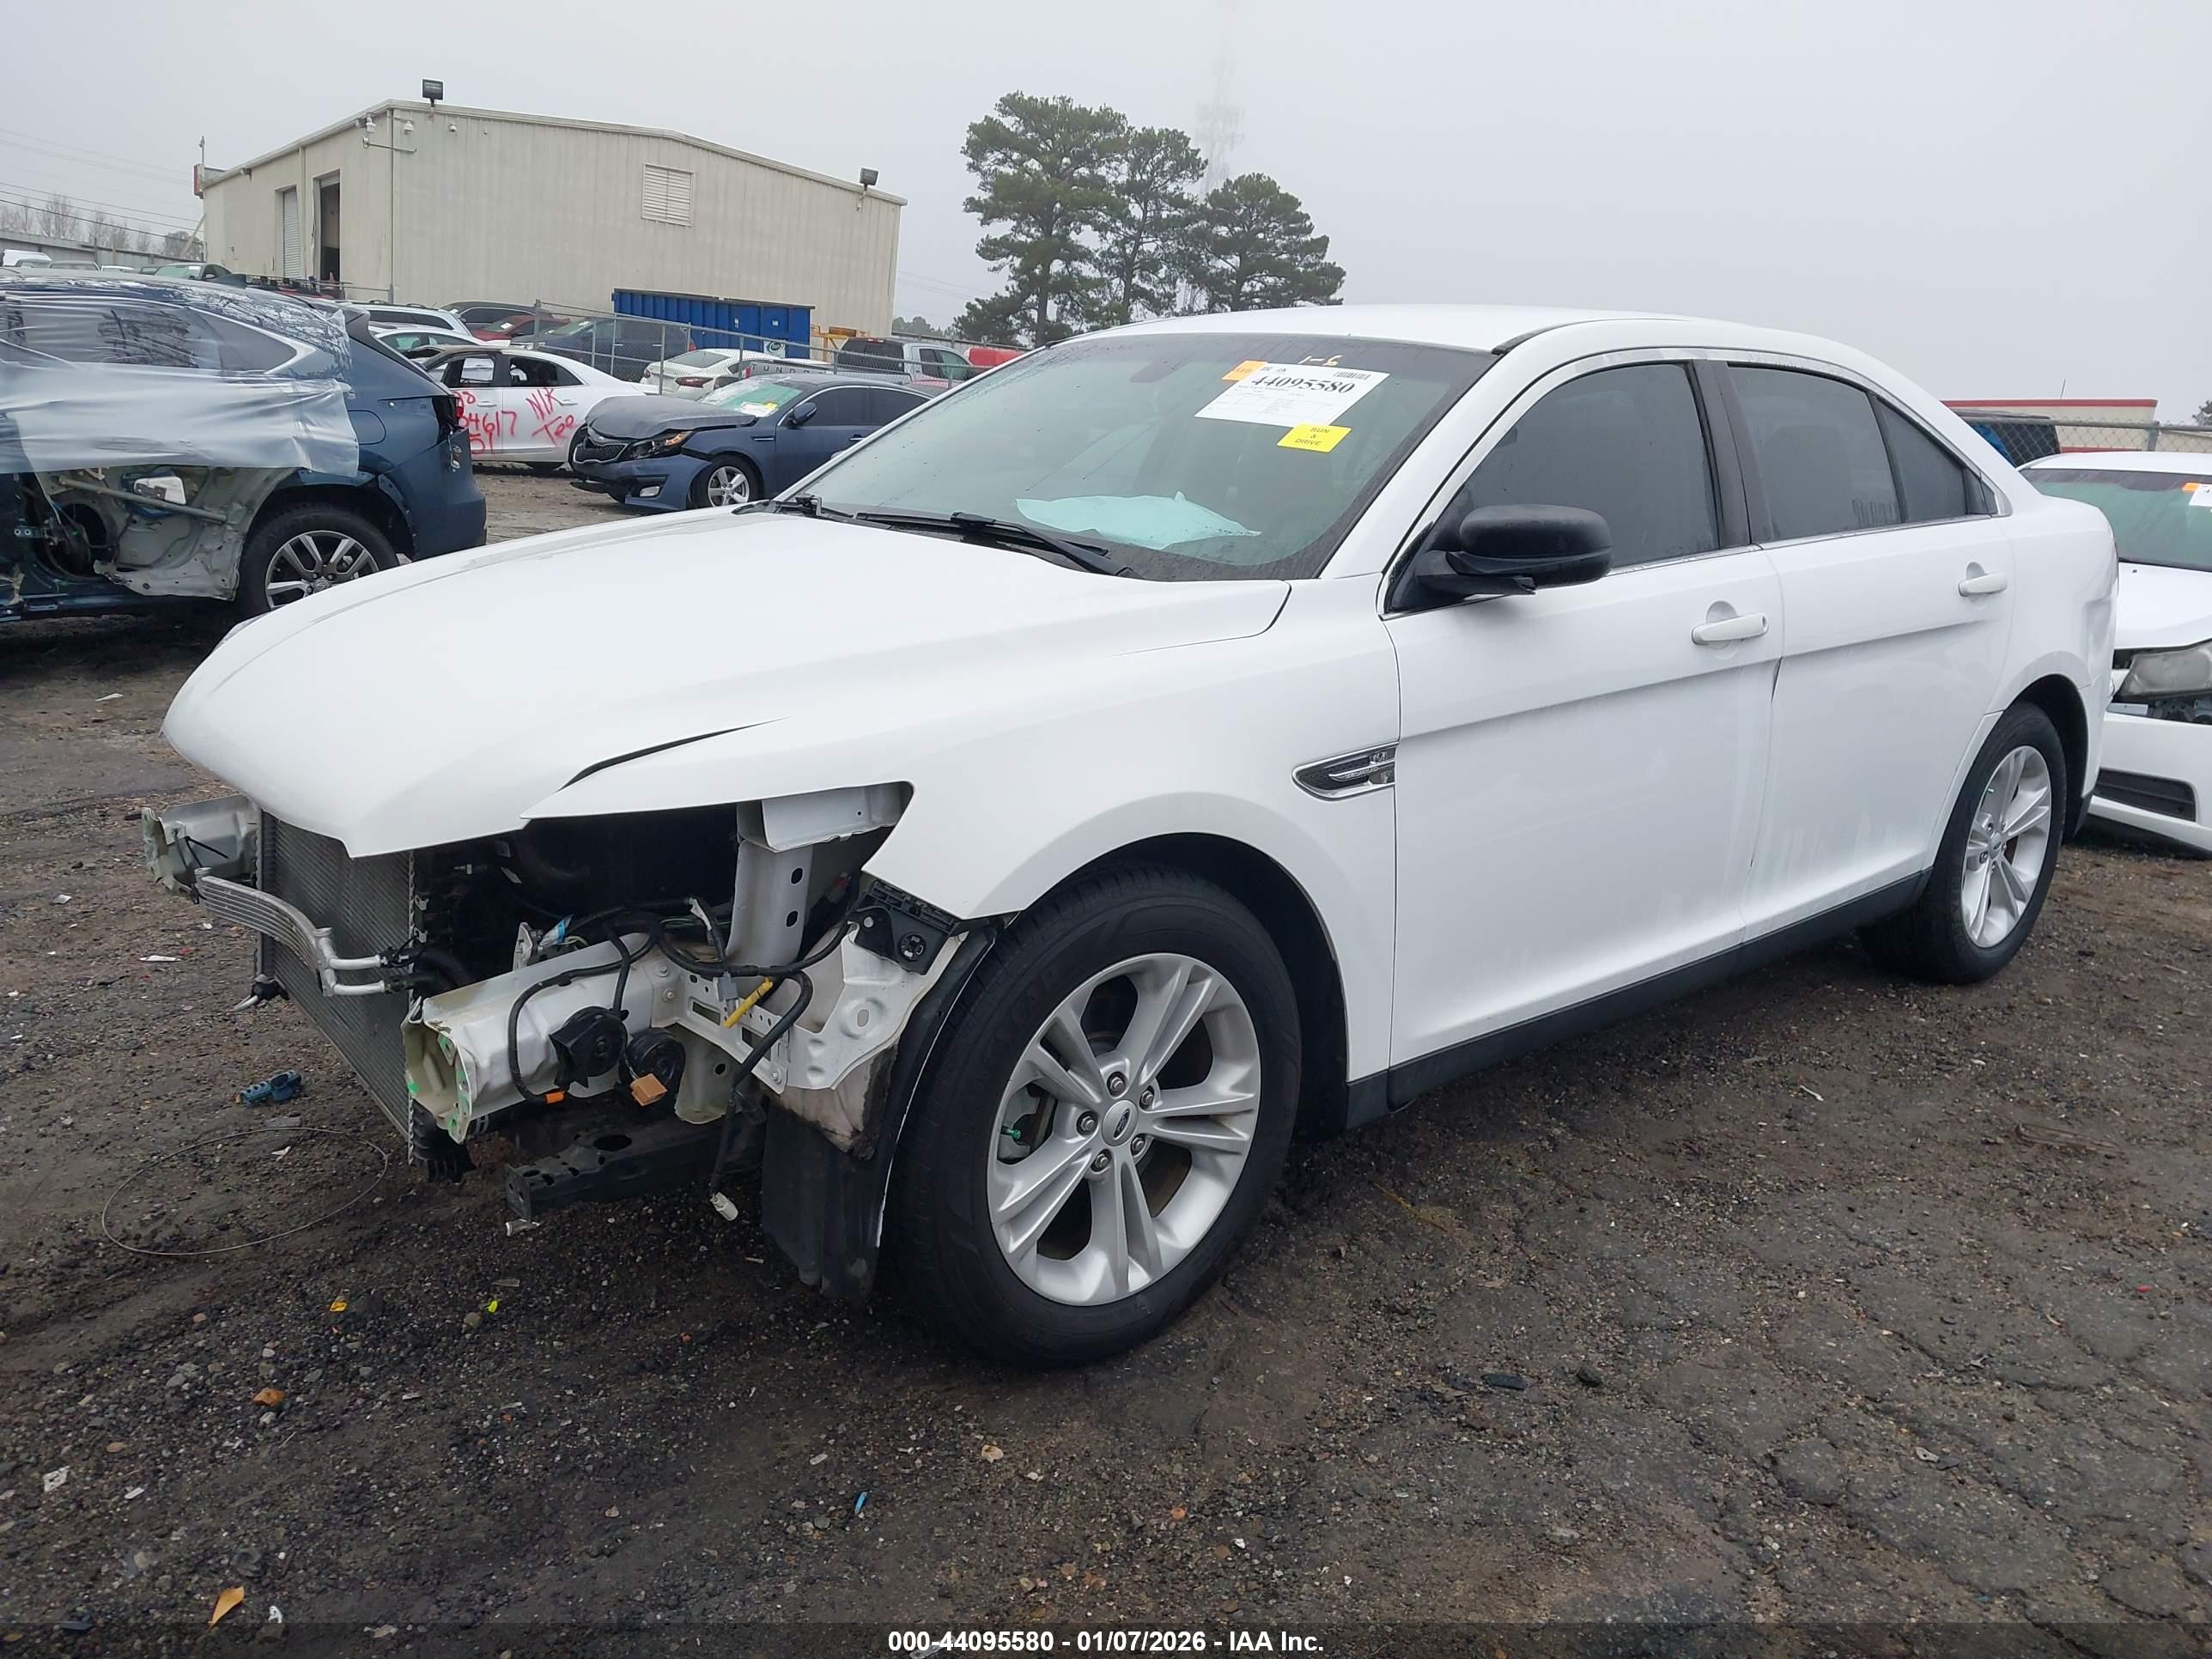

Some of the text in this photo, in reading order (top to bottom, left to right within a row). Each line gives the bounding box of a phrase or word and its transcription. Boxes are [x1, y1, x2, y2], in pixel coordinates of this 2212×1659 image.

[751, 363, 827, 374] TUND
[1251, 375, 1355, 393] 44095580
[1294, 438, 1322, 447] DRIVE
